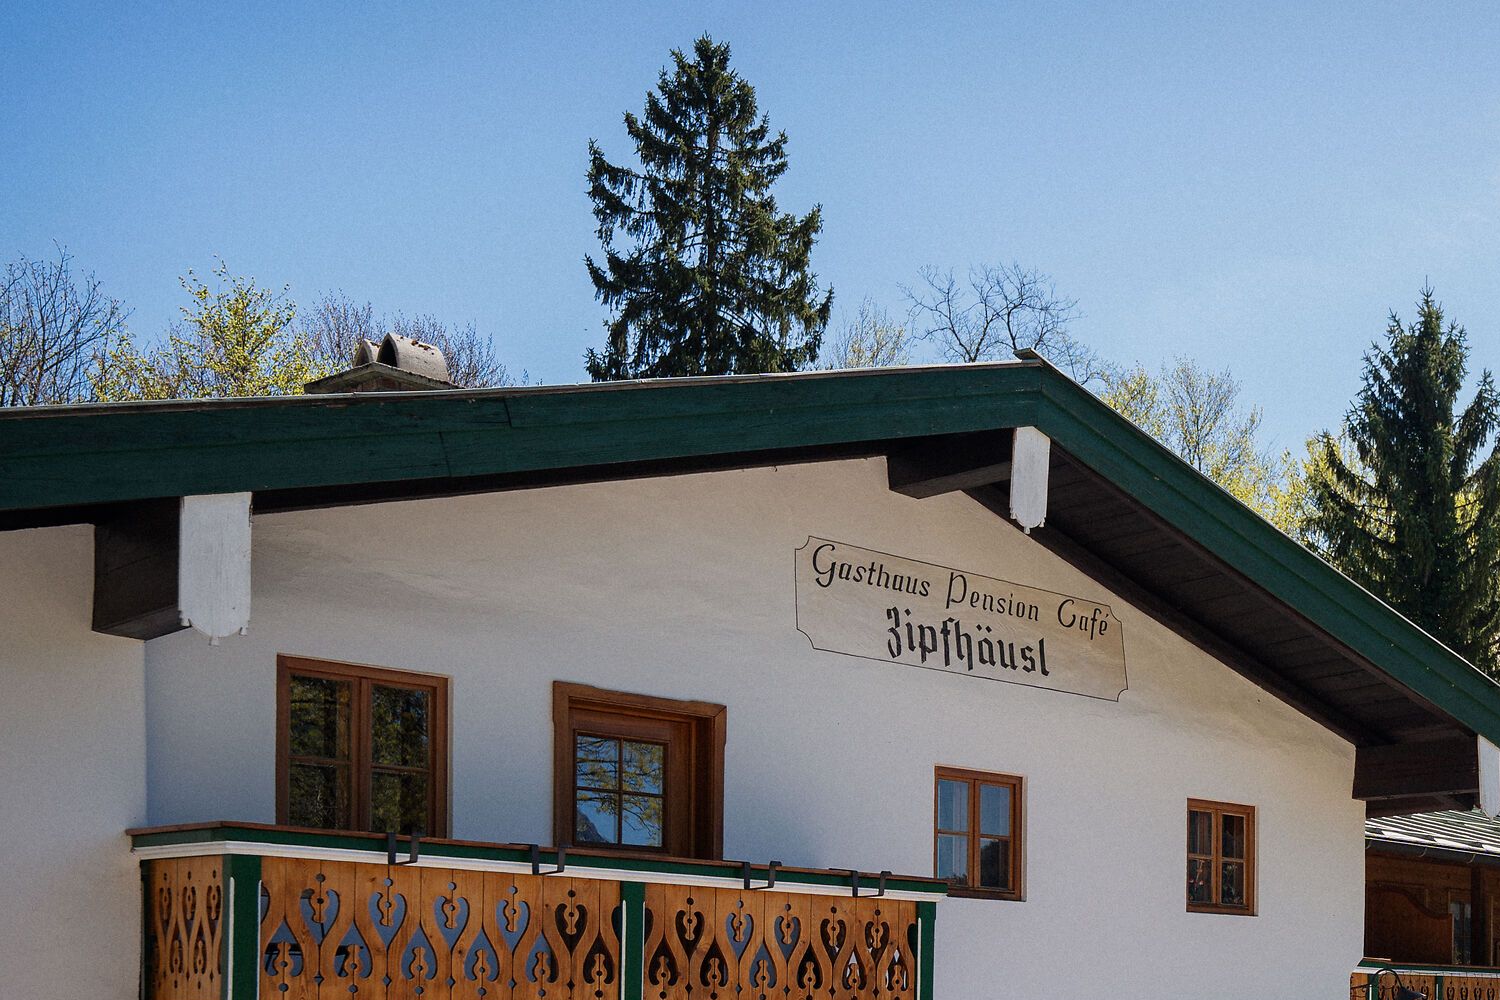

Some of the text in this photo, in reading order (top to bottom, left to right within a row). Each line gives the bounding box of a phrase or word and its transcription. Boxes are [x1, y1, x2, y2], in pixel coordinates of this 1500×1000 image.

[812, 543, 1110, 640] Gasthaus Pension Café
[886, 606, 1050, 676] Zipfhäusl
